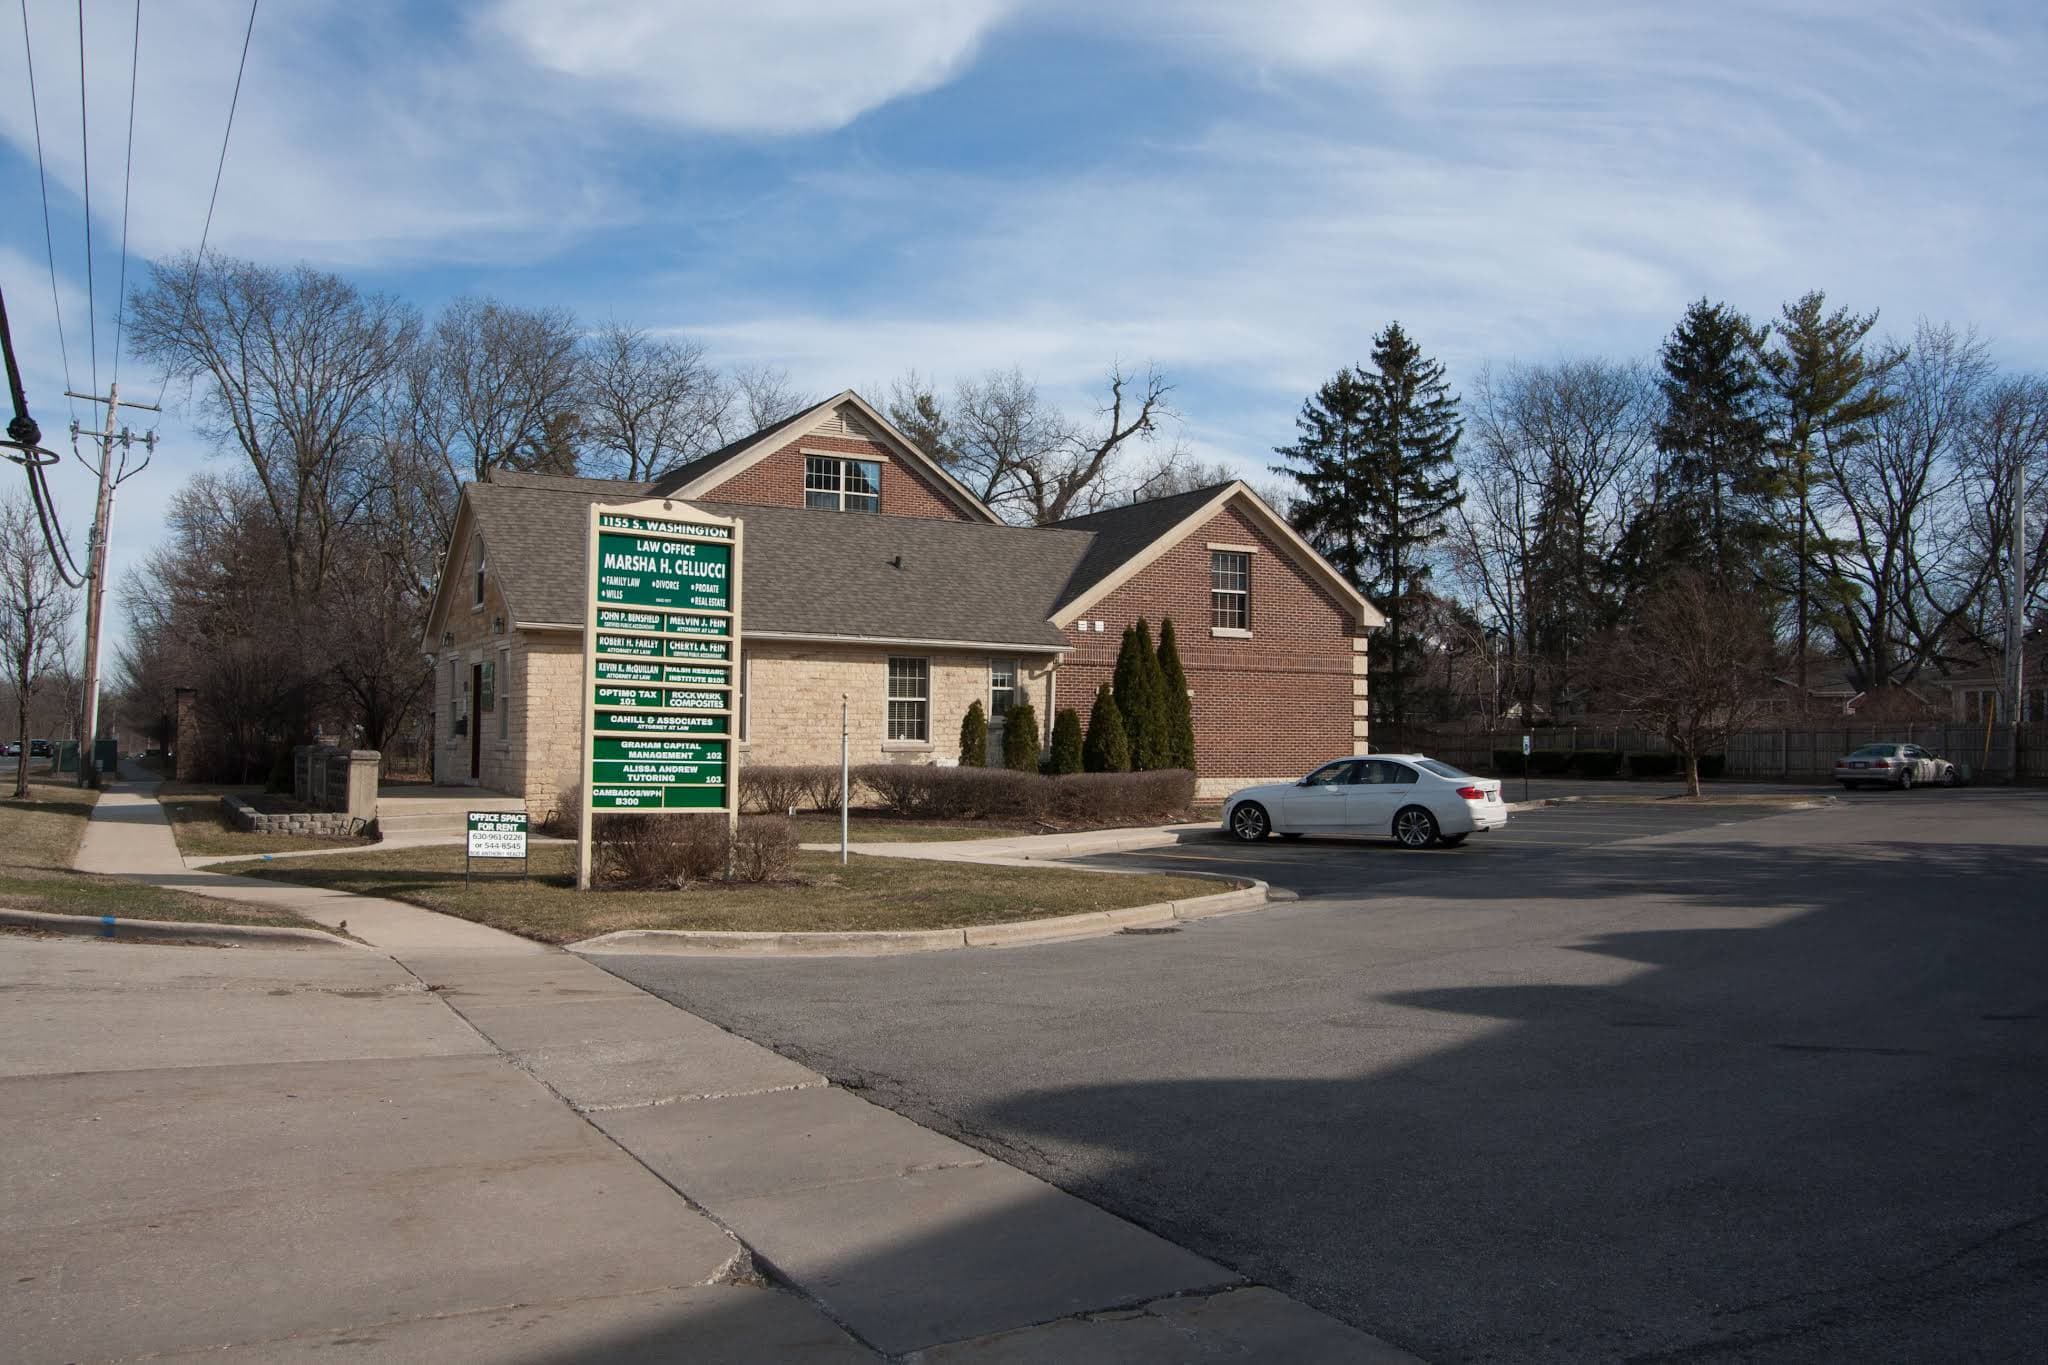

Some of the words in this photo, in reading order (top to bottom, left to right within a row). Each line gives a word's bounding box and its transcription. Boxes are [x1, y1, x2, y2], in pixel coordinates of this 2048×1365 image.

[603, 517, 629, 528] 1155
[633, 520, 643, 529] S.
[647, 522, 728, 537] WASHINGTON
[637, 540, 660, 552] LAW
[663, 543, 695, 556] OFFICE
[604, 553, 656, 572] MARSHA
[660, 558, 672, 573] H.
[675, 560, 725, 578] CELLUCCI
[606, 576, 626, 586] FAMILY
[627, 578, 640, 587] LAW
[656, 580, 680, 590] DIVORCE
[695, 583, 719, 593] PROBATE
[606, 590, 623, 599] WILLS
[694, 597, 709, 606] REAL
[708, 599, 726, 607] ESTATE
[600, 611, 619, 621] JOHN
[620, 613, 627, 621] P.
[670, 616, 699, 626] MELVIN
[701, 618, 708, 626] J.
[710, 619, 726, 628] FEIN
[599, 637, 625, 646] ROBERT
[635, 639, 659, 649] FARLEY
[670, 641, 698, 651] CHERYL
[700, 643, 708, 651] A.
[710, 643, 726, 652] FEIN
[598, 662, 617, 671] KEVIN
[599, 689, 637, 698] OPTIMO
[672, 691, 721, 700] ROCKWERK
[619, 698, 637, 706] 101
[670, 700, 724, 708] COMPOSITES
[610, 715, 645, 724] CAHILL
[647, 716, 655, 724] &
[657, 717, 714, 726] ASSOCIATES
[621, 741, 662, 749] GRAHAM
[663, 742, 702, 750] CAPITAL
[628, 751, 694, 760] MANAGEMENT
[706, 752, 723, 760] 102
[623, 765, 657, 773] ALISSA
[658, 766, 699, 774] ANDREW
[627, 774, 676, 782] TUTORING
[706, 776, 722, 784] 103
[615, 797, 639, 806] B300
[470, 813, 500, 822] OFFICE
[500, 814, 527, 823] SPACE
[478, 822, 495, 831] FOR
[496, 823, 519, 832] RENT
